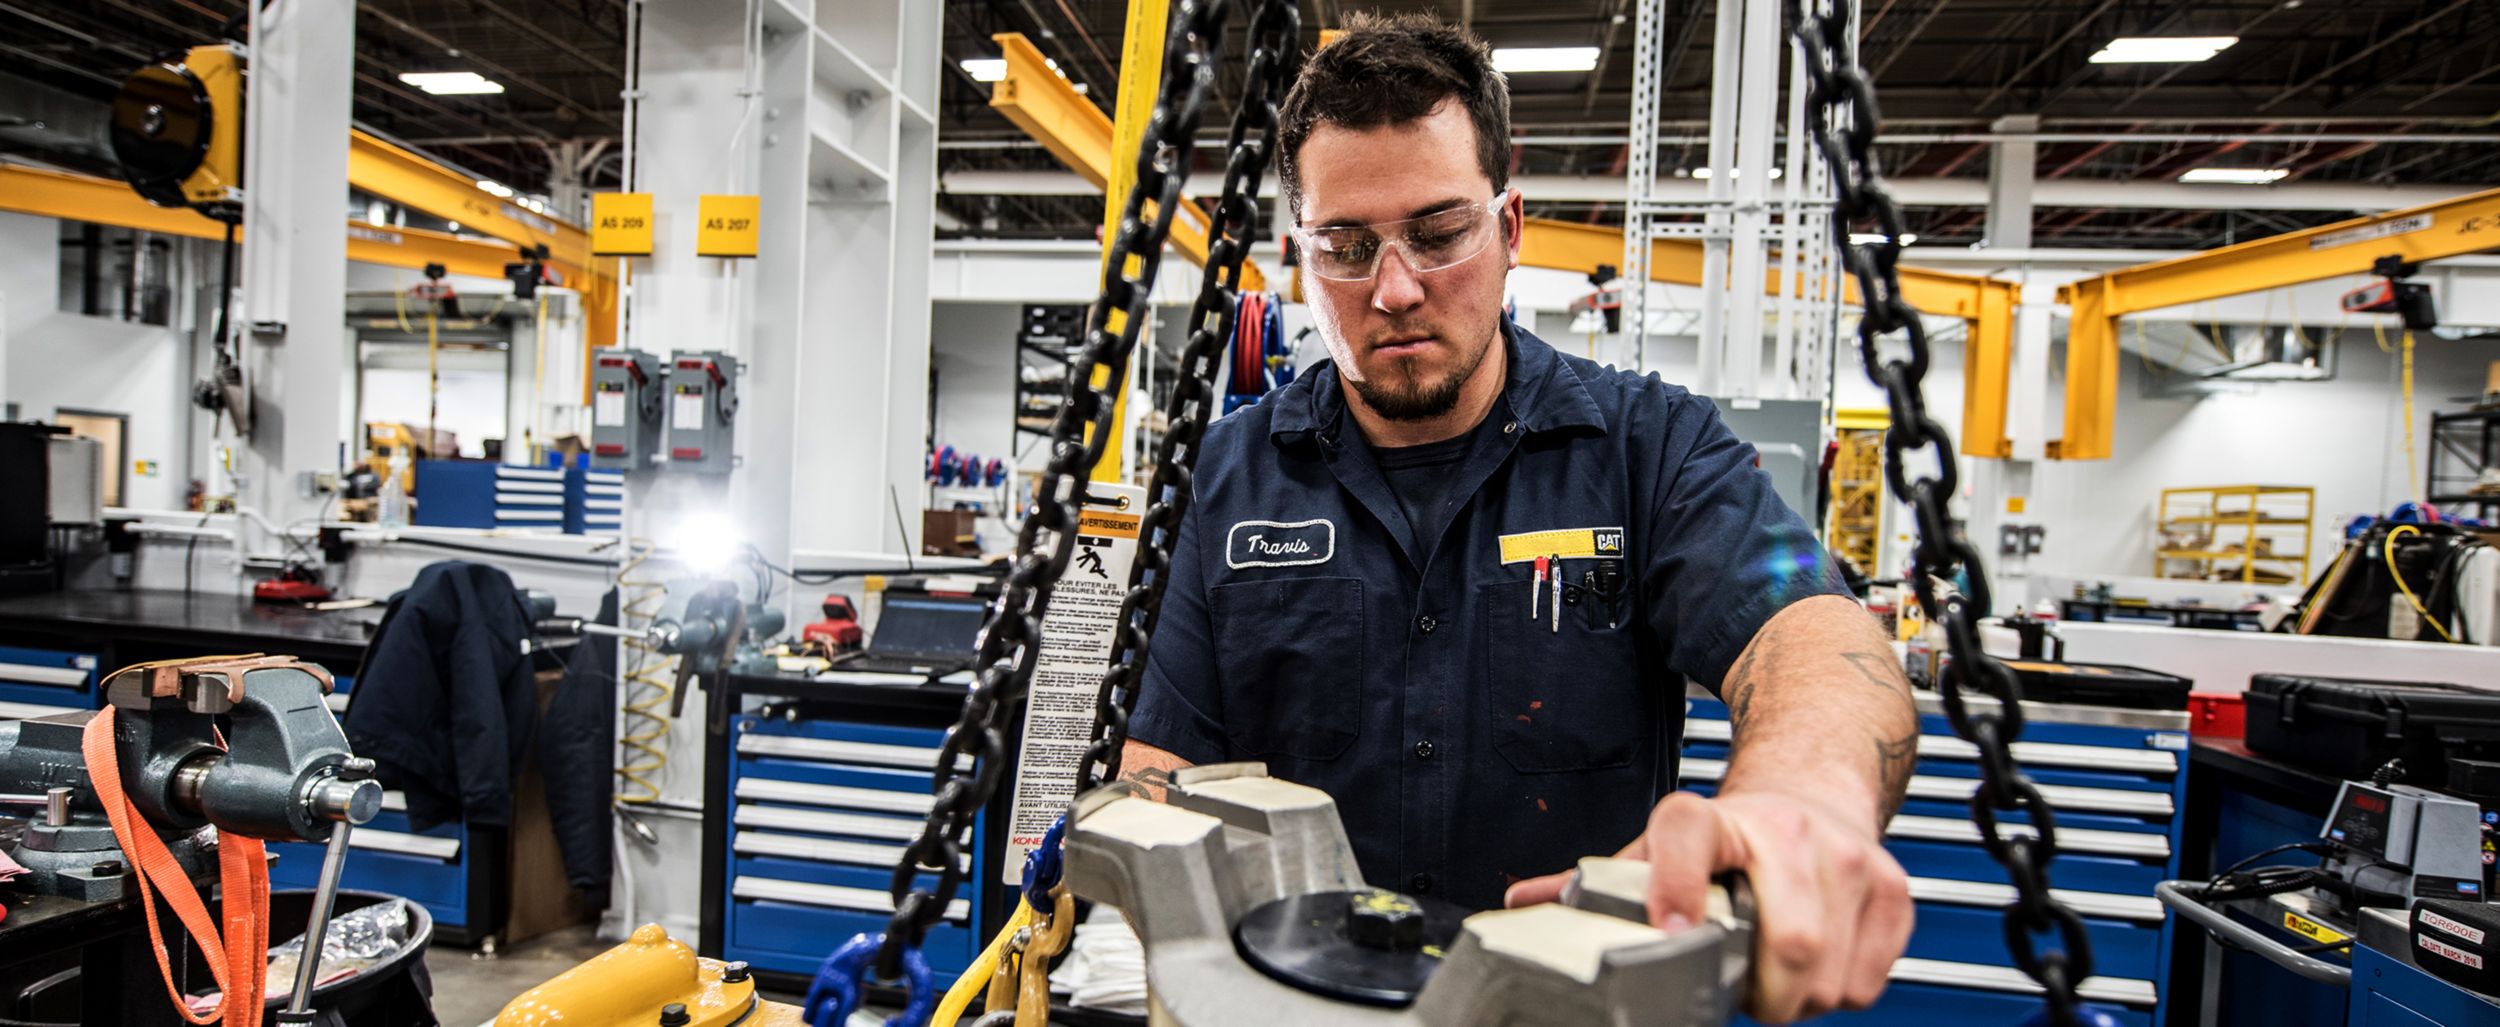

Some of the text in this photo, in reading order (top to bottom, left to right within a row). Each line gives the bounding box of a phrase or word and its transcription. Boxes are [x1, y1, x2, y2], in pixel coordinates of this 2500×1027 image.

[602, 218, 644, 228] AS 209
[706, 219, 751, 230] AS 207
[1079, 518, 1138, 531] AVERTISSEMENT
[1248, 534, 1310, 555] Travis
[1597, 534, 1621, 551] CAT
